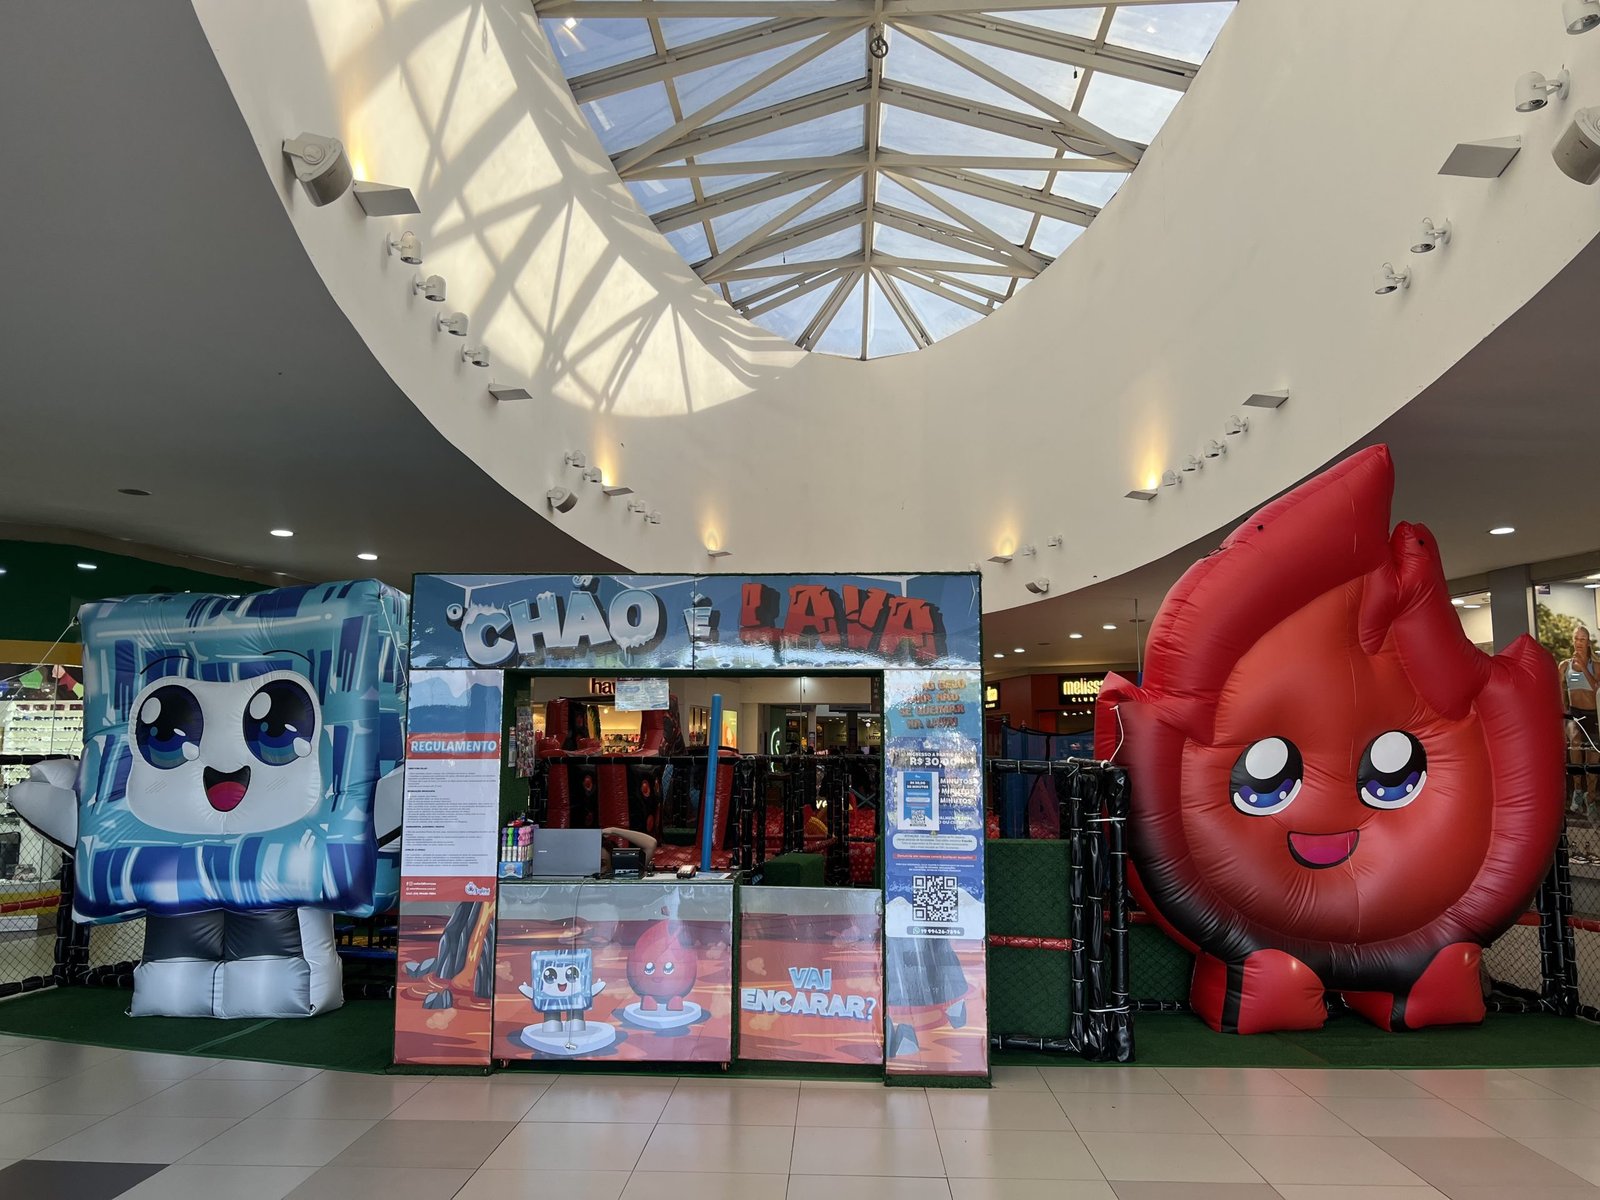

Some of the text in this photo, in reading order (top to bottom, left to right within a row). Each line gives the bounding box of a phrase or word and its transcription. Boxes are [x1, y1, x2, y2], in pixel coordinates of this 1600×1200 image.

[460, 575, 660, 666] CHÃO
[738, 582, 940, 660] LAVA
[1063, 678, 1104, 695] meliss
[410, 740, 497, 753] REGULAMENTO
[909, 757, 923, 766] R$
[788, 966, 832, 992] VAI
[740, 988, 877, 1021] ENCARAR?
